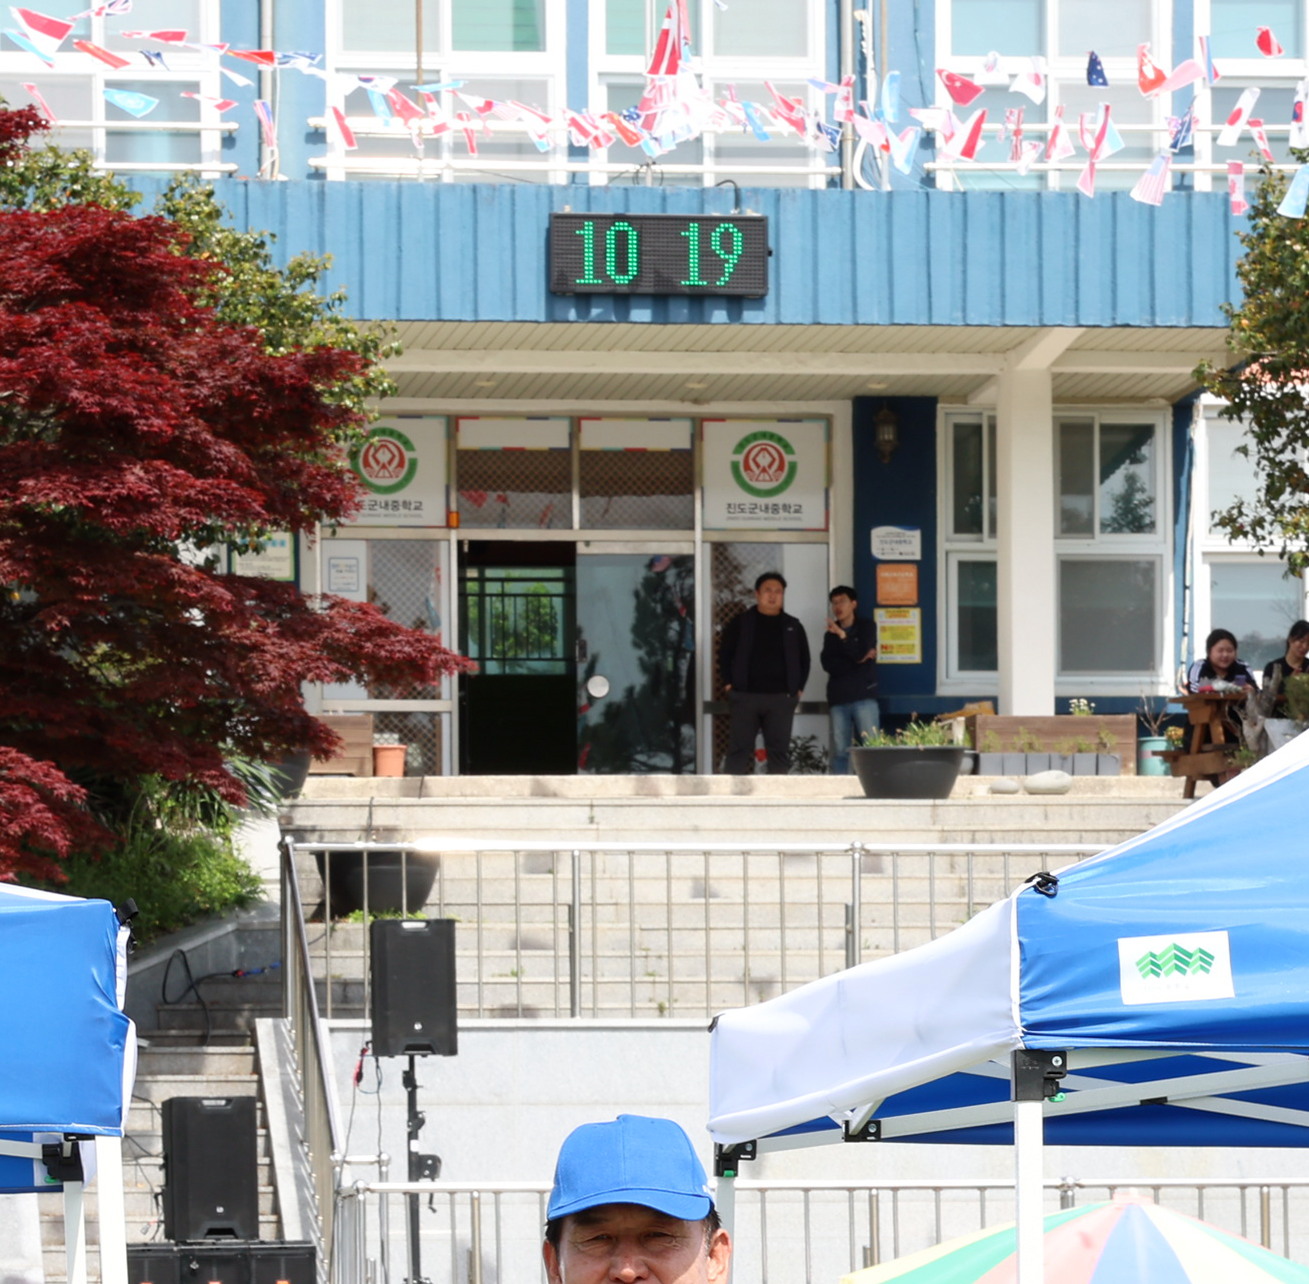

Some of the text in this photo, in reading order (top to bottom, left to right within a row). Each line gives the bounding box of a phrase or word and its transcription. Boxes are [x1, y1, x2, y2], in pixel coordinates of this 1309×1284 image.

[575, 221, 743, 286] 10 19
[356, 500, 424, 511] 도군내중학교
[726, 502, 803, 515] 진도군내중학교
